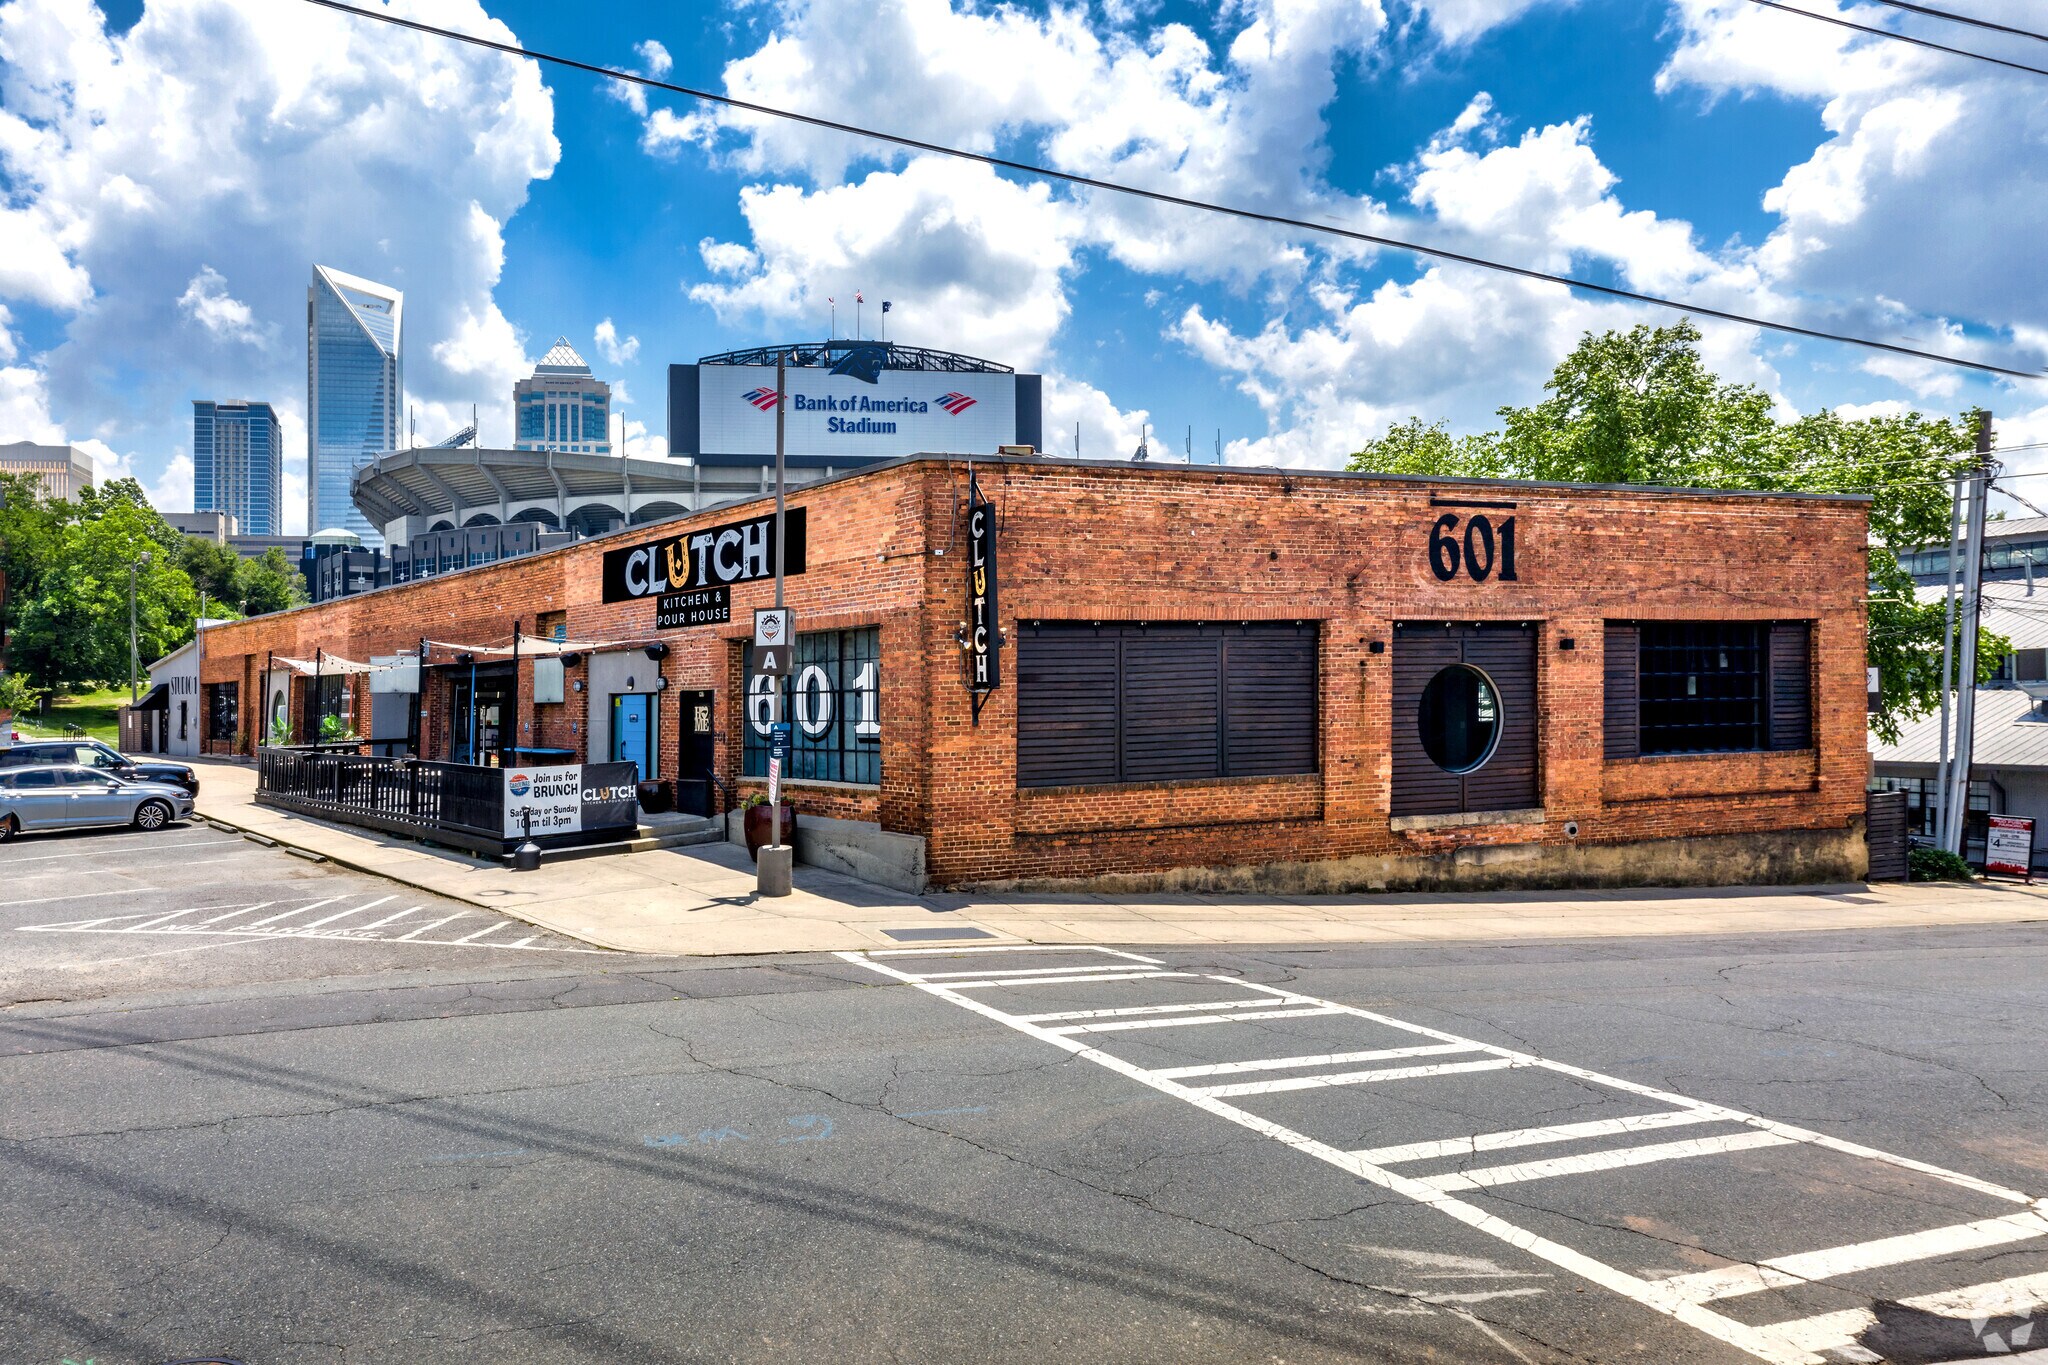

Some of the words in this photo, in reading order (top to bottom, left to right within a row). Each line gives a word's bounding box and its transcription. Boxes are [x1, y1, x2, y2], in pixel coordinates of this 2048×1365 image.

[794, 394, 838, 411] Bank
[840, 395, 858, 412] of
[860, 396, 928, 413] America
[828, 416, 897, 434] Stadium
[1429, 513, 1518, 582] 601
[625, 520, 770, 597] CLUTCH
[663, 592, 709, 609] KITCHEN
[715, 591, 722, 602] &
[971, 511, 988, 683] CLUTCH
[657, 612, 685, 626] POUR
[691, 607, 729, 622] HOUSE
[763, 651, 777, 670] A
[749, 662, 881, 736] 601
[533, 773, 551, 784] Join
[553, 774, 563, 782] us
[565, 771, 578, 781] for
[533, 783, 578, 799] BRUNCH
[582, 784, 637, 801] CLUTCH
[510, 806, 542, 818] Satday
[553, 805, 579, 815] Sunday
[542, 817, 551, 827] til
[553, 816, 572, 828] 3pm
